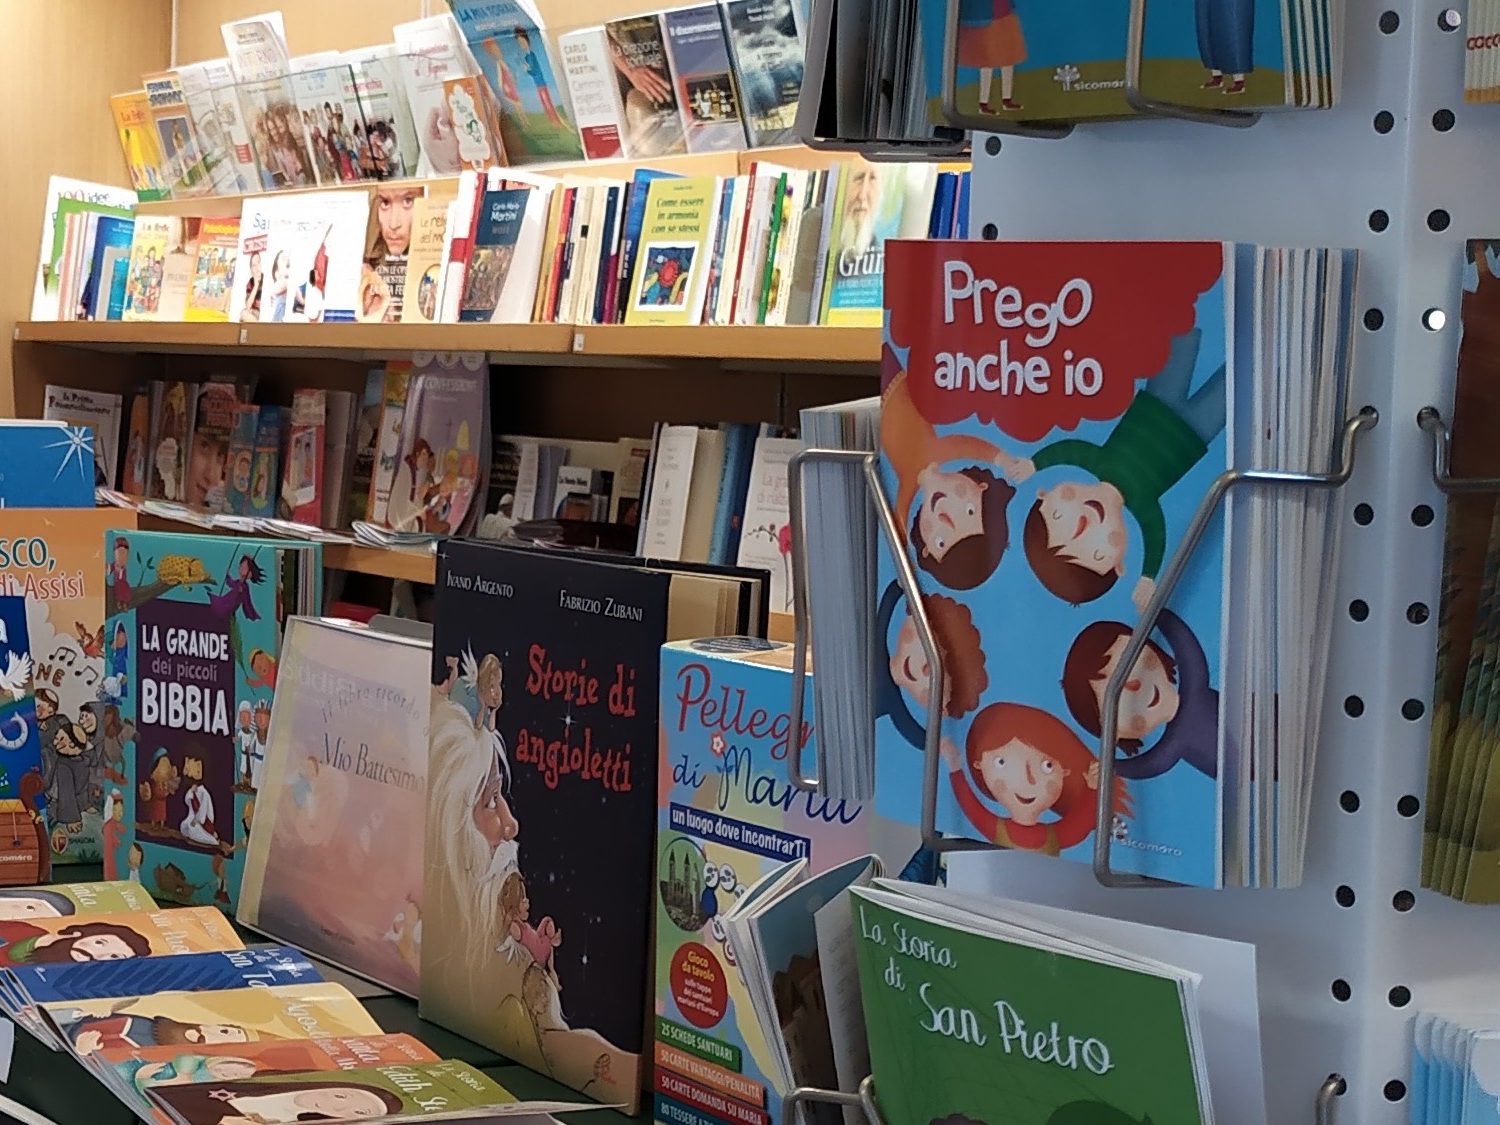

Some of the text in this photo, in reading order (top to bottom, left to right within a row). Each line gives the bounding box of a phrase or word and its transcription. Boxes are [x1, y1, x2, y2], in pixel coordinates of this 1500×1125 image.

[564, 43, 587, 54] CARLO
[568, 65, 598, 75] MARTINI
[491, 211, 517, 222] Martini
[666, 209, 699, 220] armonia
[680, 197, 704, 206] essere
[944, 260, 1093, 348] Prego
[934, 339, 1103, 396] anche io
[24, 571, 84, 599] Assisi
[142, 625, 230, 661] LA GRANDE
[151, 656, 217, 681] dei piccoli
[526, 643, 636, 718] Storie di
[142, 679, 230, 736] BIBBIA
[320, 733, 351, 770] Mio
[516, 727, 632, 792] angioletti
[673, 755, 707, 788] di
[673, 810, 740, 840] un luogo dove
[859, 905, 957, 969] La Storia
[688, 951, 709, 968] Gioco
[692, 965, 715, 983] tavolo
[884, 957, 905, 991] di
[670, 1025, 733, 1061] SCHEDE SANTUARI
[919, 982, 1115, 1075] San Pietro
[669, 1052, 690, 1072] CARTE
[670, 1078, 691, 1098] CARTE
[691, 1086, 727, 1113] DOMANDA
